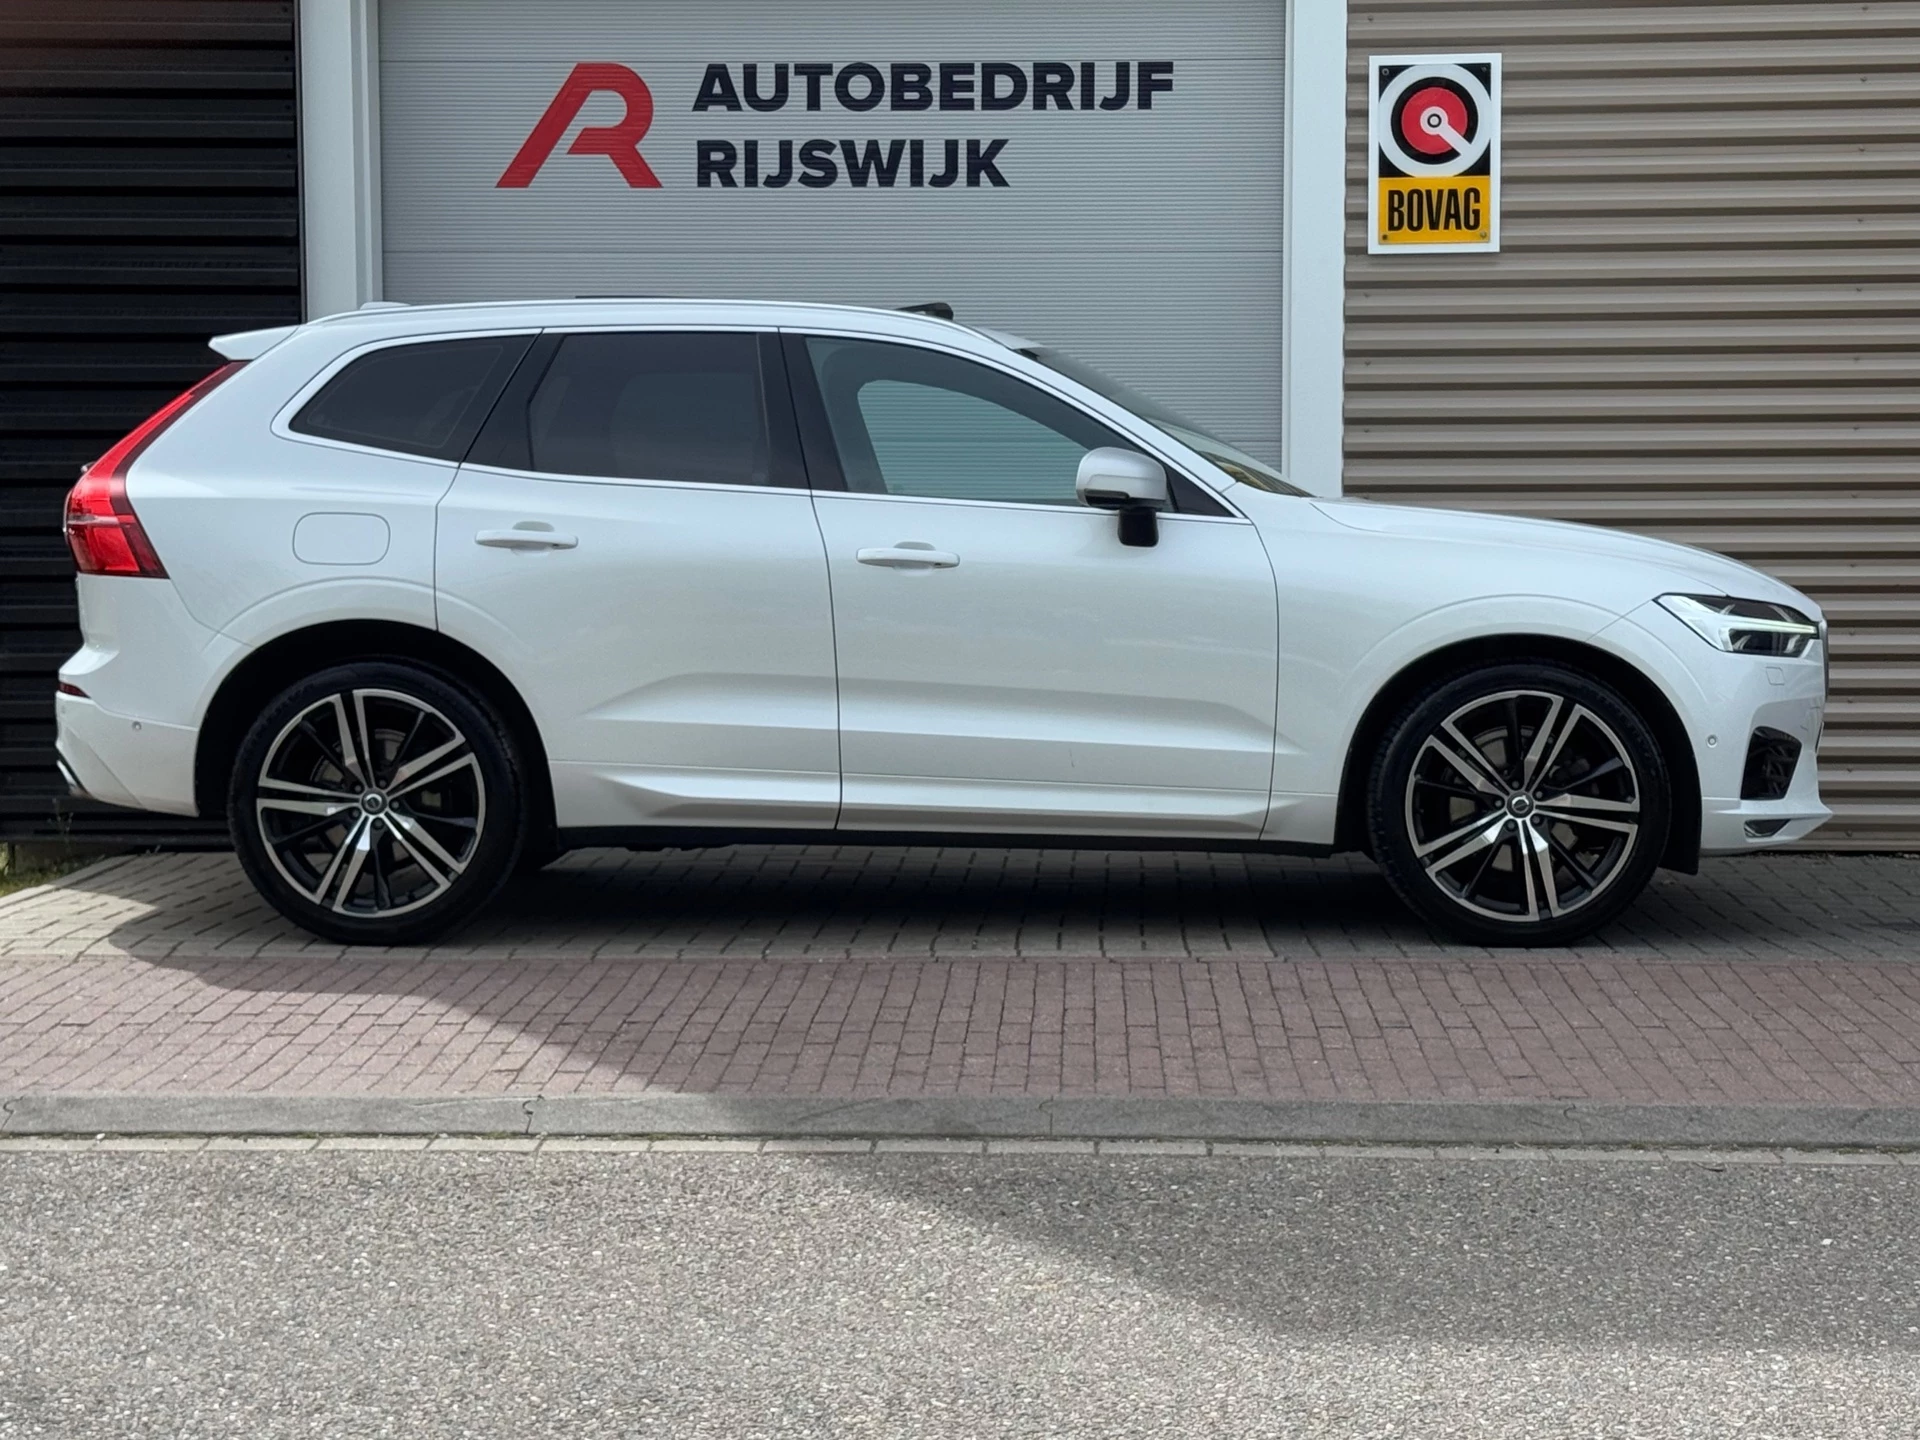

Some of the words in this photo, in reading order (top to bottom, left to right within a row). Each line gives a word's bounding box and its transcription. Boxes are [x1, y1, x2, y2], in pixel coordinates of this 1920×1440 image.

[693, 61, 1174, 112] AUTOBEDRIJF
[697, 139, 1011, 188] RIJSWIJK
[1388, 187, 1481, 231] BOVAG
